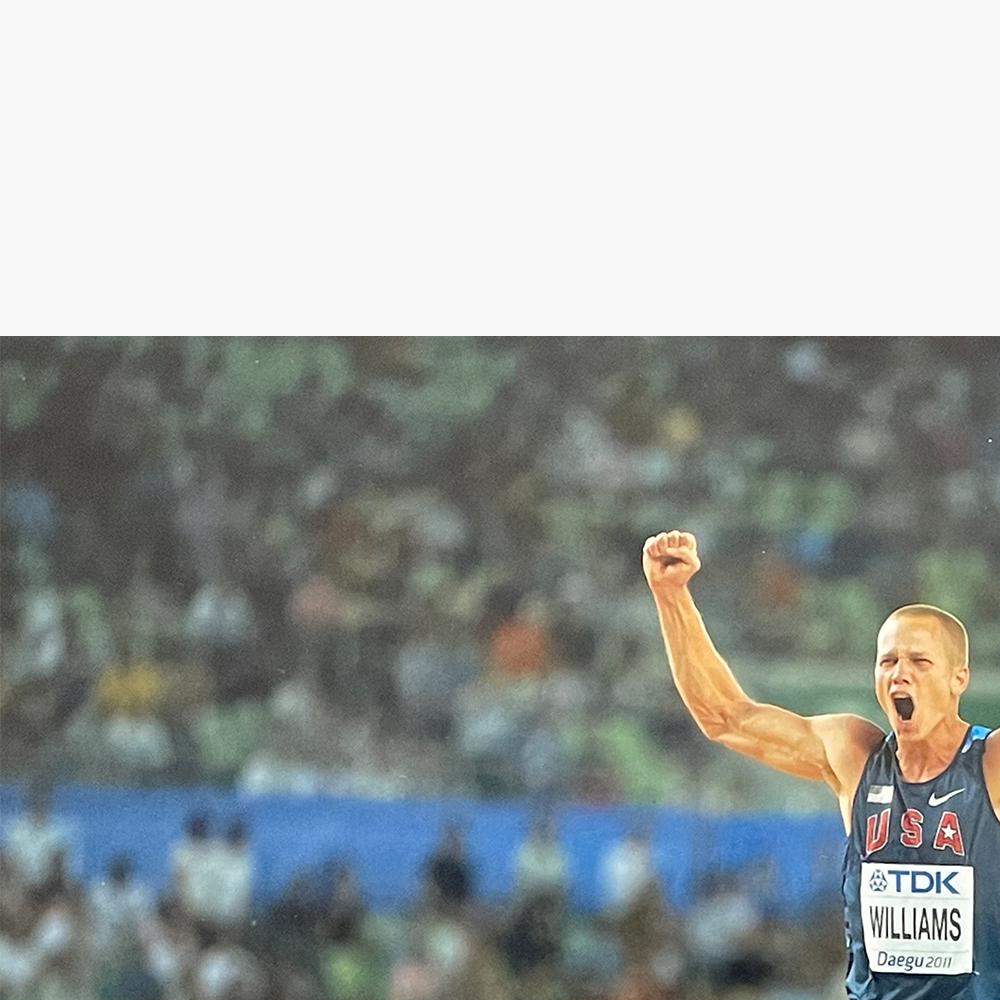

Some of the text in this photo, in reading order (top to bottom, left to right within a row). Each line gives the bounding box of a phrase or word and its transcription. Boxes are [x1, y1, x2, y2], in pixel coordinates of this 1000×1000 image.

[866, 808, 965, 856] USA
[888, 870, 960, 894] TDK
[869, 906, 962, 941] WILLIAMS
[877, 951, 952, 971] Daegu 2011
